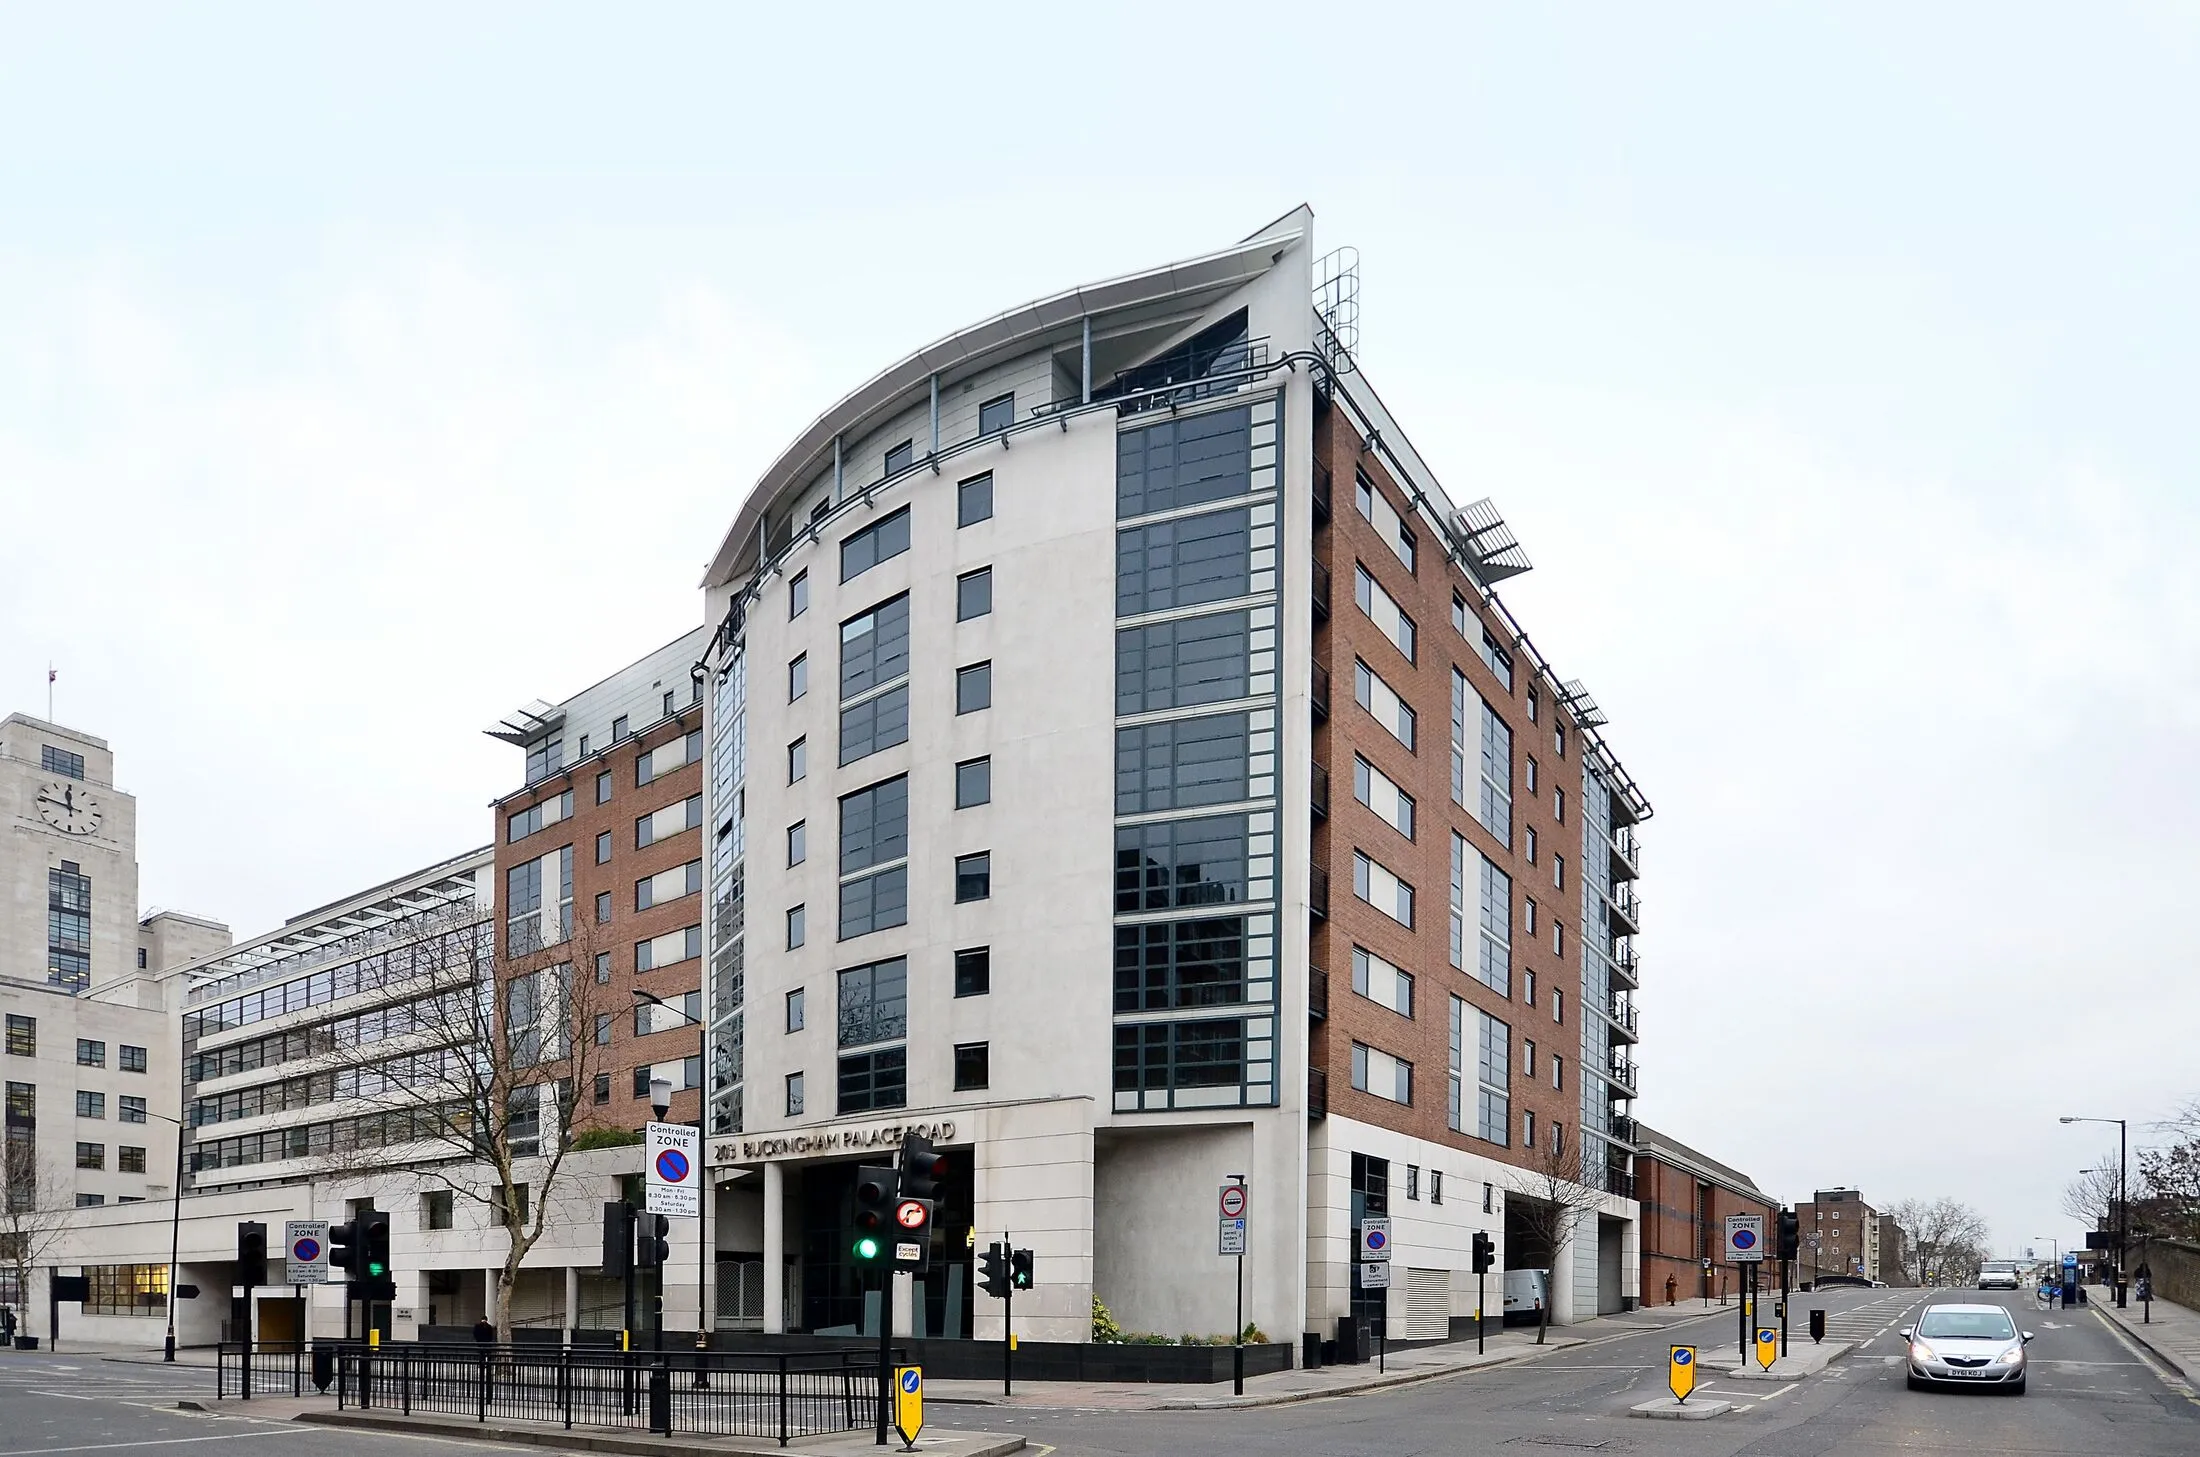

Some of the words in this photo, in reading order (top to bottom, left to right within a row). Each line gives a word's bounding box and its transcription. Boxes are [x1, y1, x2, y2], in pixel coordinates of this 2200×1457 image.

[650, 1124, 696, 1137] Controlled
[656, 1135, 689, 1147] ZONE
[743, 1131, 841, 1158] BUCKINGHAM
[844, 1126, 902, 1147] PALACE
